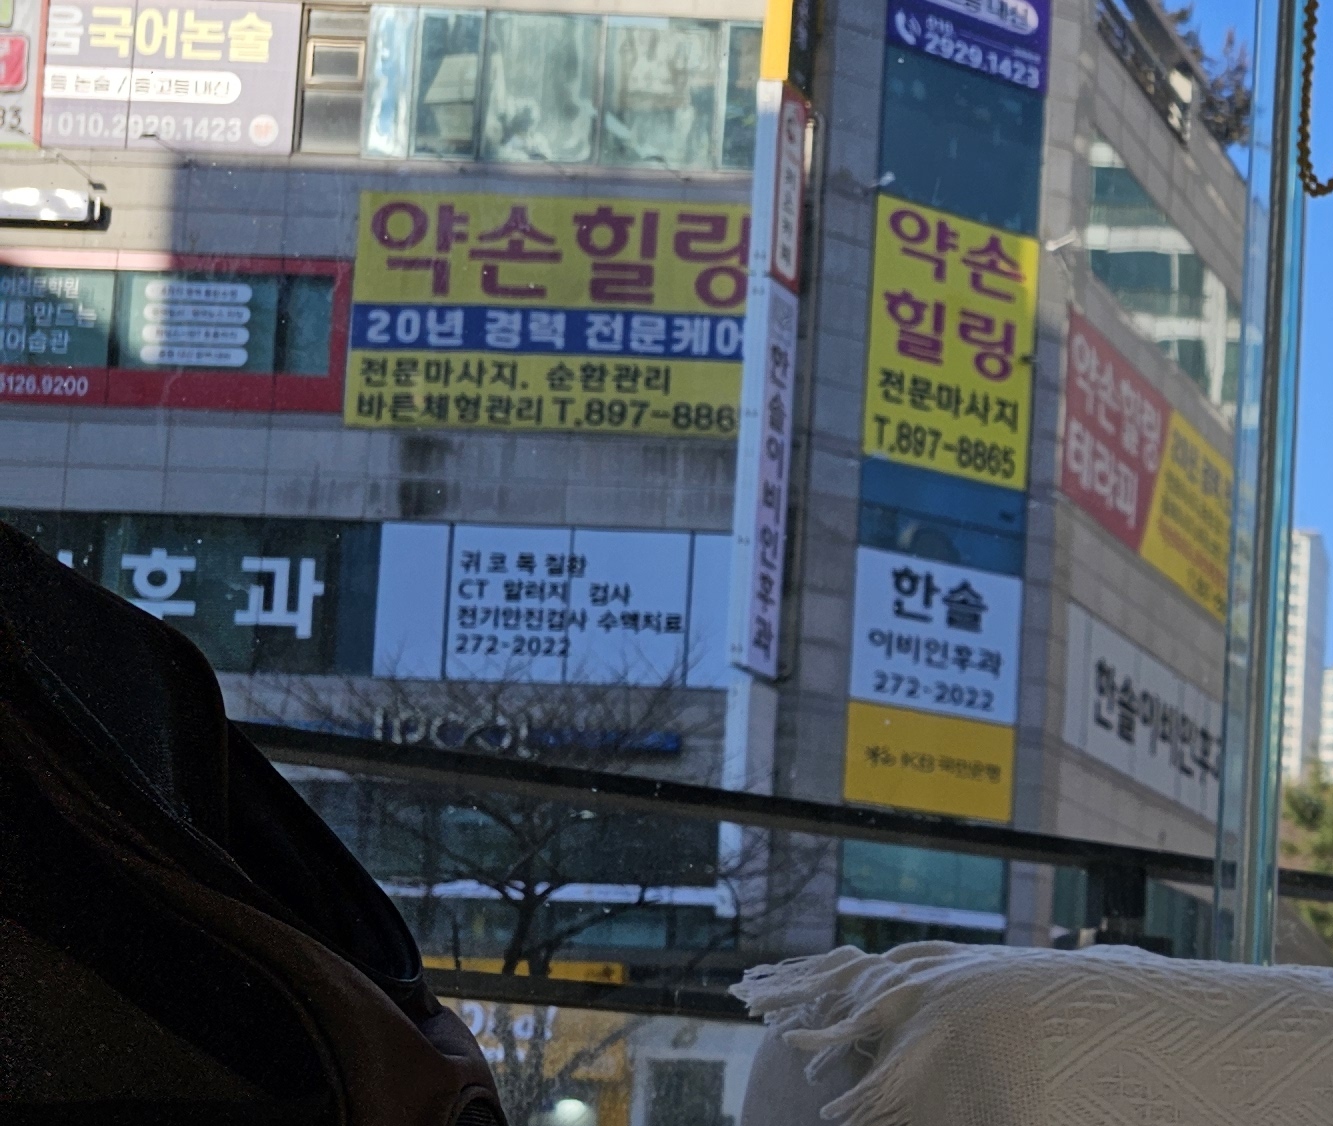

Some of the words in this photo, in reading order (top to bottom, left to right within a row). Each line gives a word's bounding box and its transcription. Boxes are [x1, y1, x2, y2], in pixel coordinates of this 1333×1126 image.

[88, 7, 274, 63] 국어논술
[57, 110, 243, 143] 010.2929.1423
[371, 201, 751, 309] 약손힐링
[889, 209, 1027, 303] 약손
[366, 307, 465, 347] 20년
[484, 309, 567, 350] 경력
[884, 289, 1017, 382] 힐링
[545, 361, 672, 396] 순환관리
[878, 367, 1019, 434] 전문마사지
[57, 548, 325, 640] 후과
[457, 578, 489, 600] CT
[891, 564, 988, 634] 한솔
[867, 627, 1004, 680] 이비인후과
[872, 669, 995, 712] 272-2022
[1093, 655, 1222, 781] 한솔이비인후
